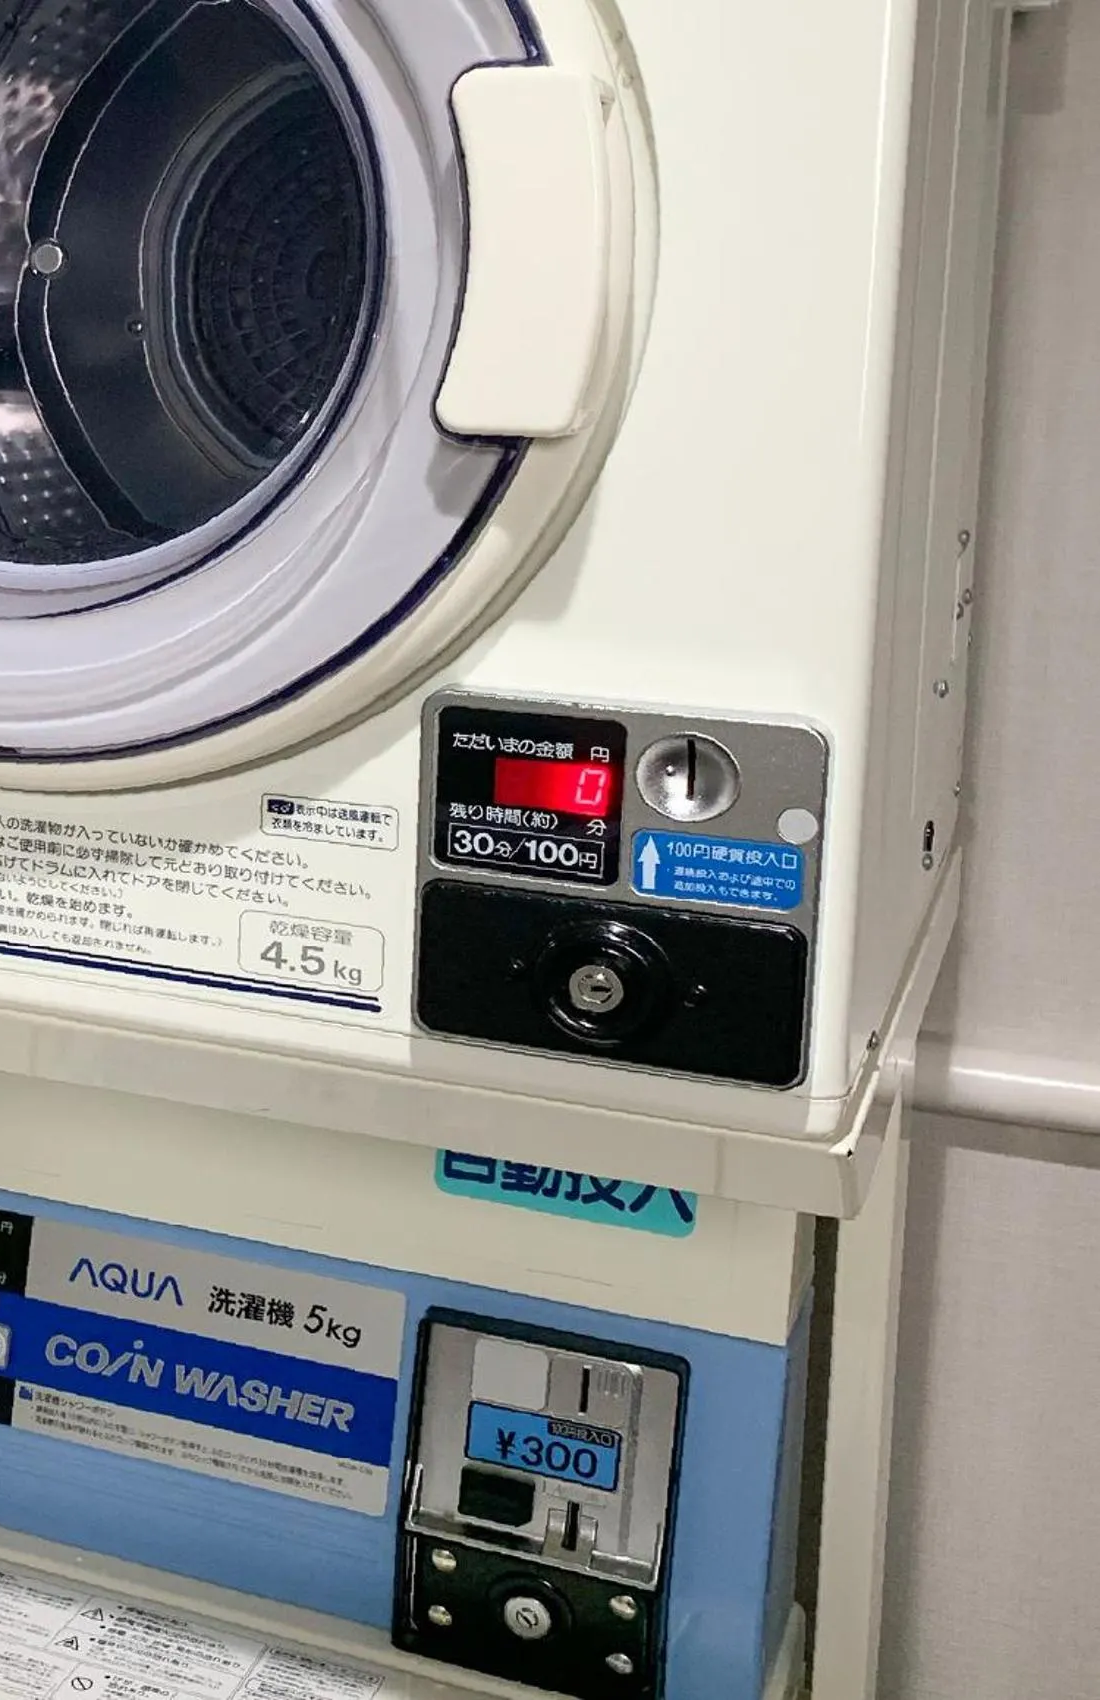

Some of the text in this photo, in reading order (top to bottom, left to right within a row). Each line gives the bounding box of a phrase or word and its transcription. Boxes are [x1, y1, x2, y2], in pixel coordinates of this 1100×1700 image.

[452, 731, 610, 763] ただいまの金額 円
[575, 767, 608, 806] 0
[272, 816, 385, 843] 衣類を冷ましています。
[448, 801, 608, 836] 残り時間(約) 分
[452, 829, 599, 870] 30分/100円
[666, 840, 798, 870] 100円硬貨投入口
[673, 880, 779, 902] 追加投入もできます。
[269, 919, 353, 947] 乾燥容量
[260, 940, 363, 987] 4.5 kg
[0, 1220, 15, 1236] 円
[68, 1257, 363, 1349] AQUA 洗濯機 5kg
[174, 1363, 357, 1433] WASHER
[495, 1426, 598, 1480] ¥300
